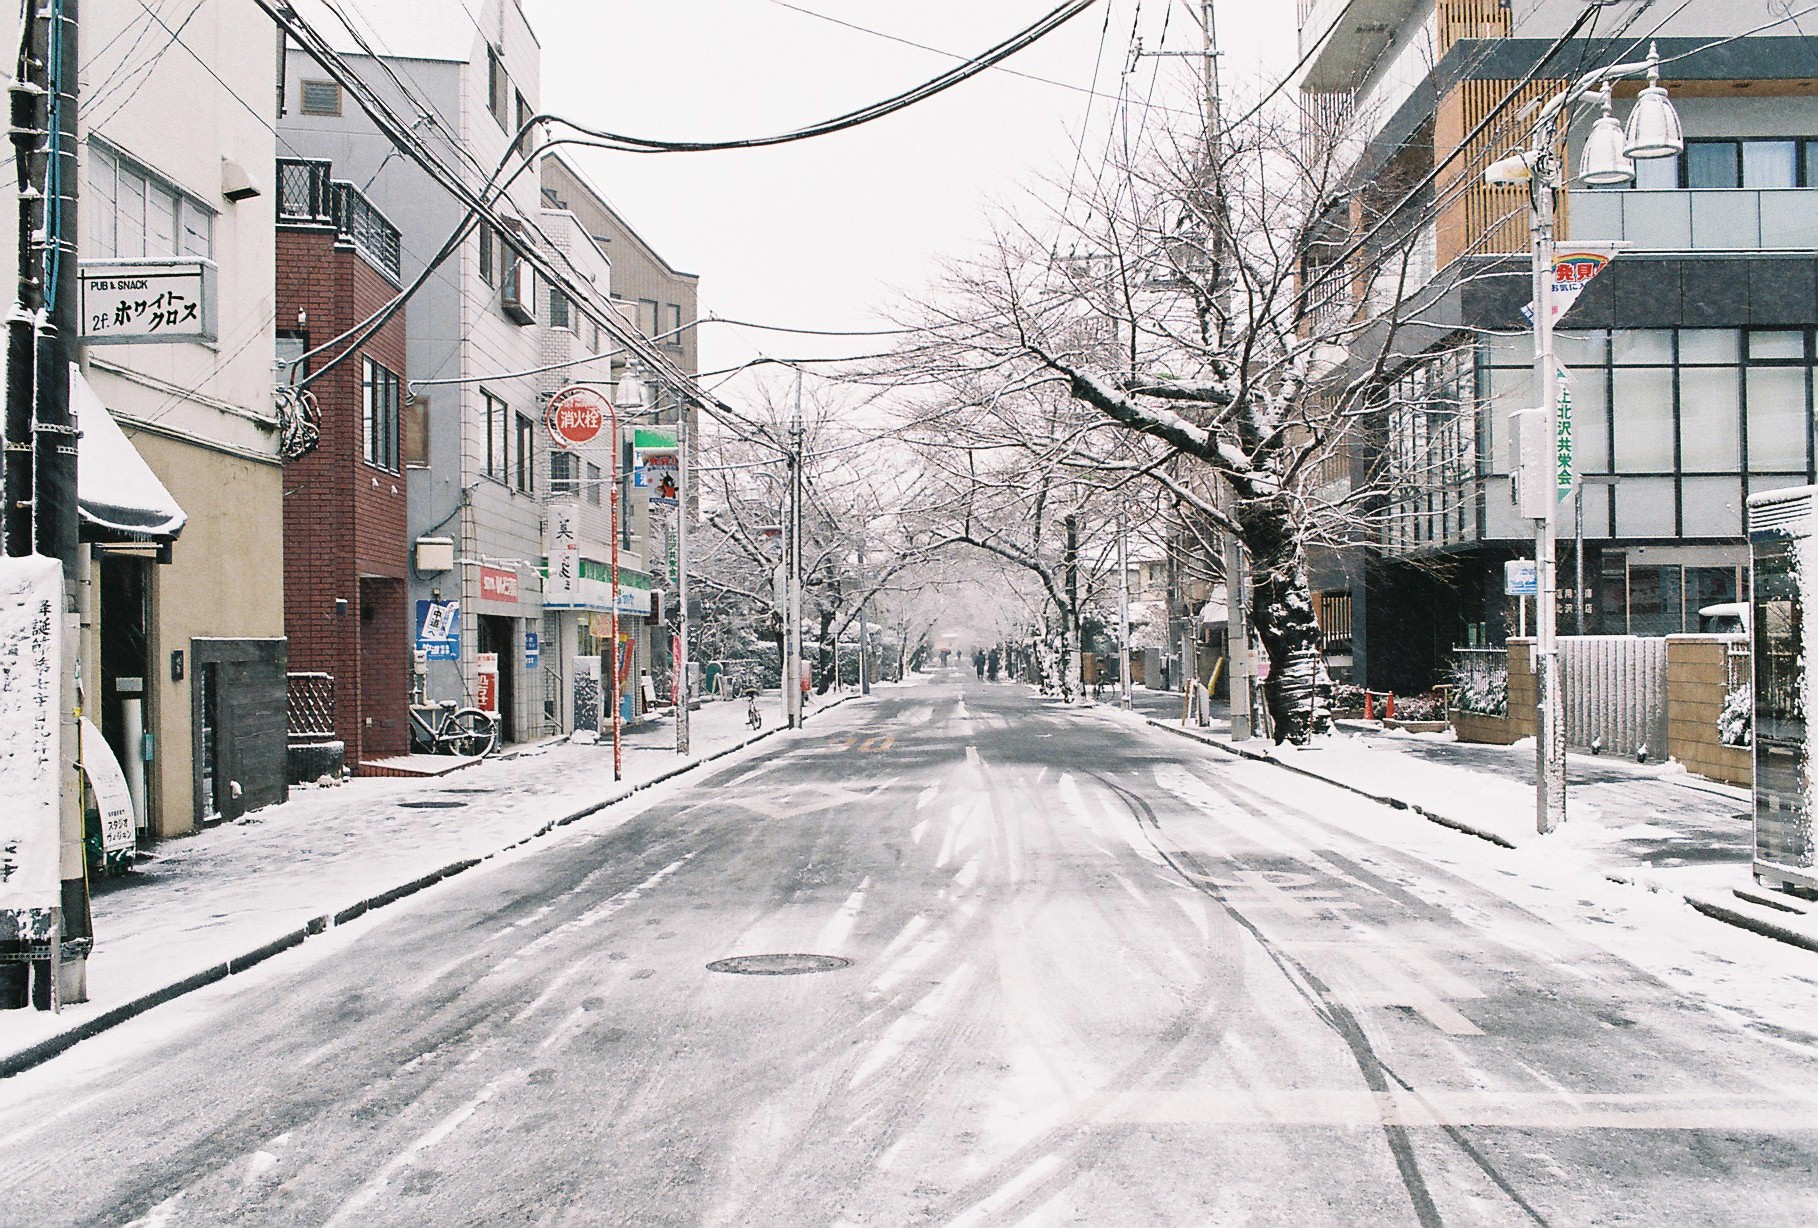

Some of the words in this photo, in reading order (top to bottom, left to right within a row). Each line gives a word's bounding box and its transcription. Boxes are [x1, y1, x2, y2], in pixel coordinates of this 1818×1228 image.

[91, 281, 108, 290] PUB
[117, 280, 148, 290] SNACK
[113, 291, 184, 326] ホワイト
[148, 303, 197, 332] クロス
[560, 410, 599, 429] 消火栓
[1557, 387, 1572, 485] 上北沢共栄会
